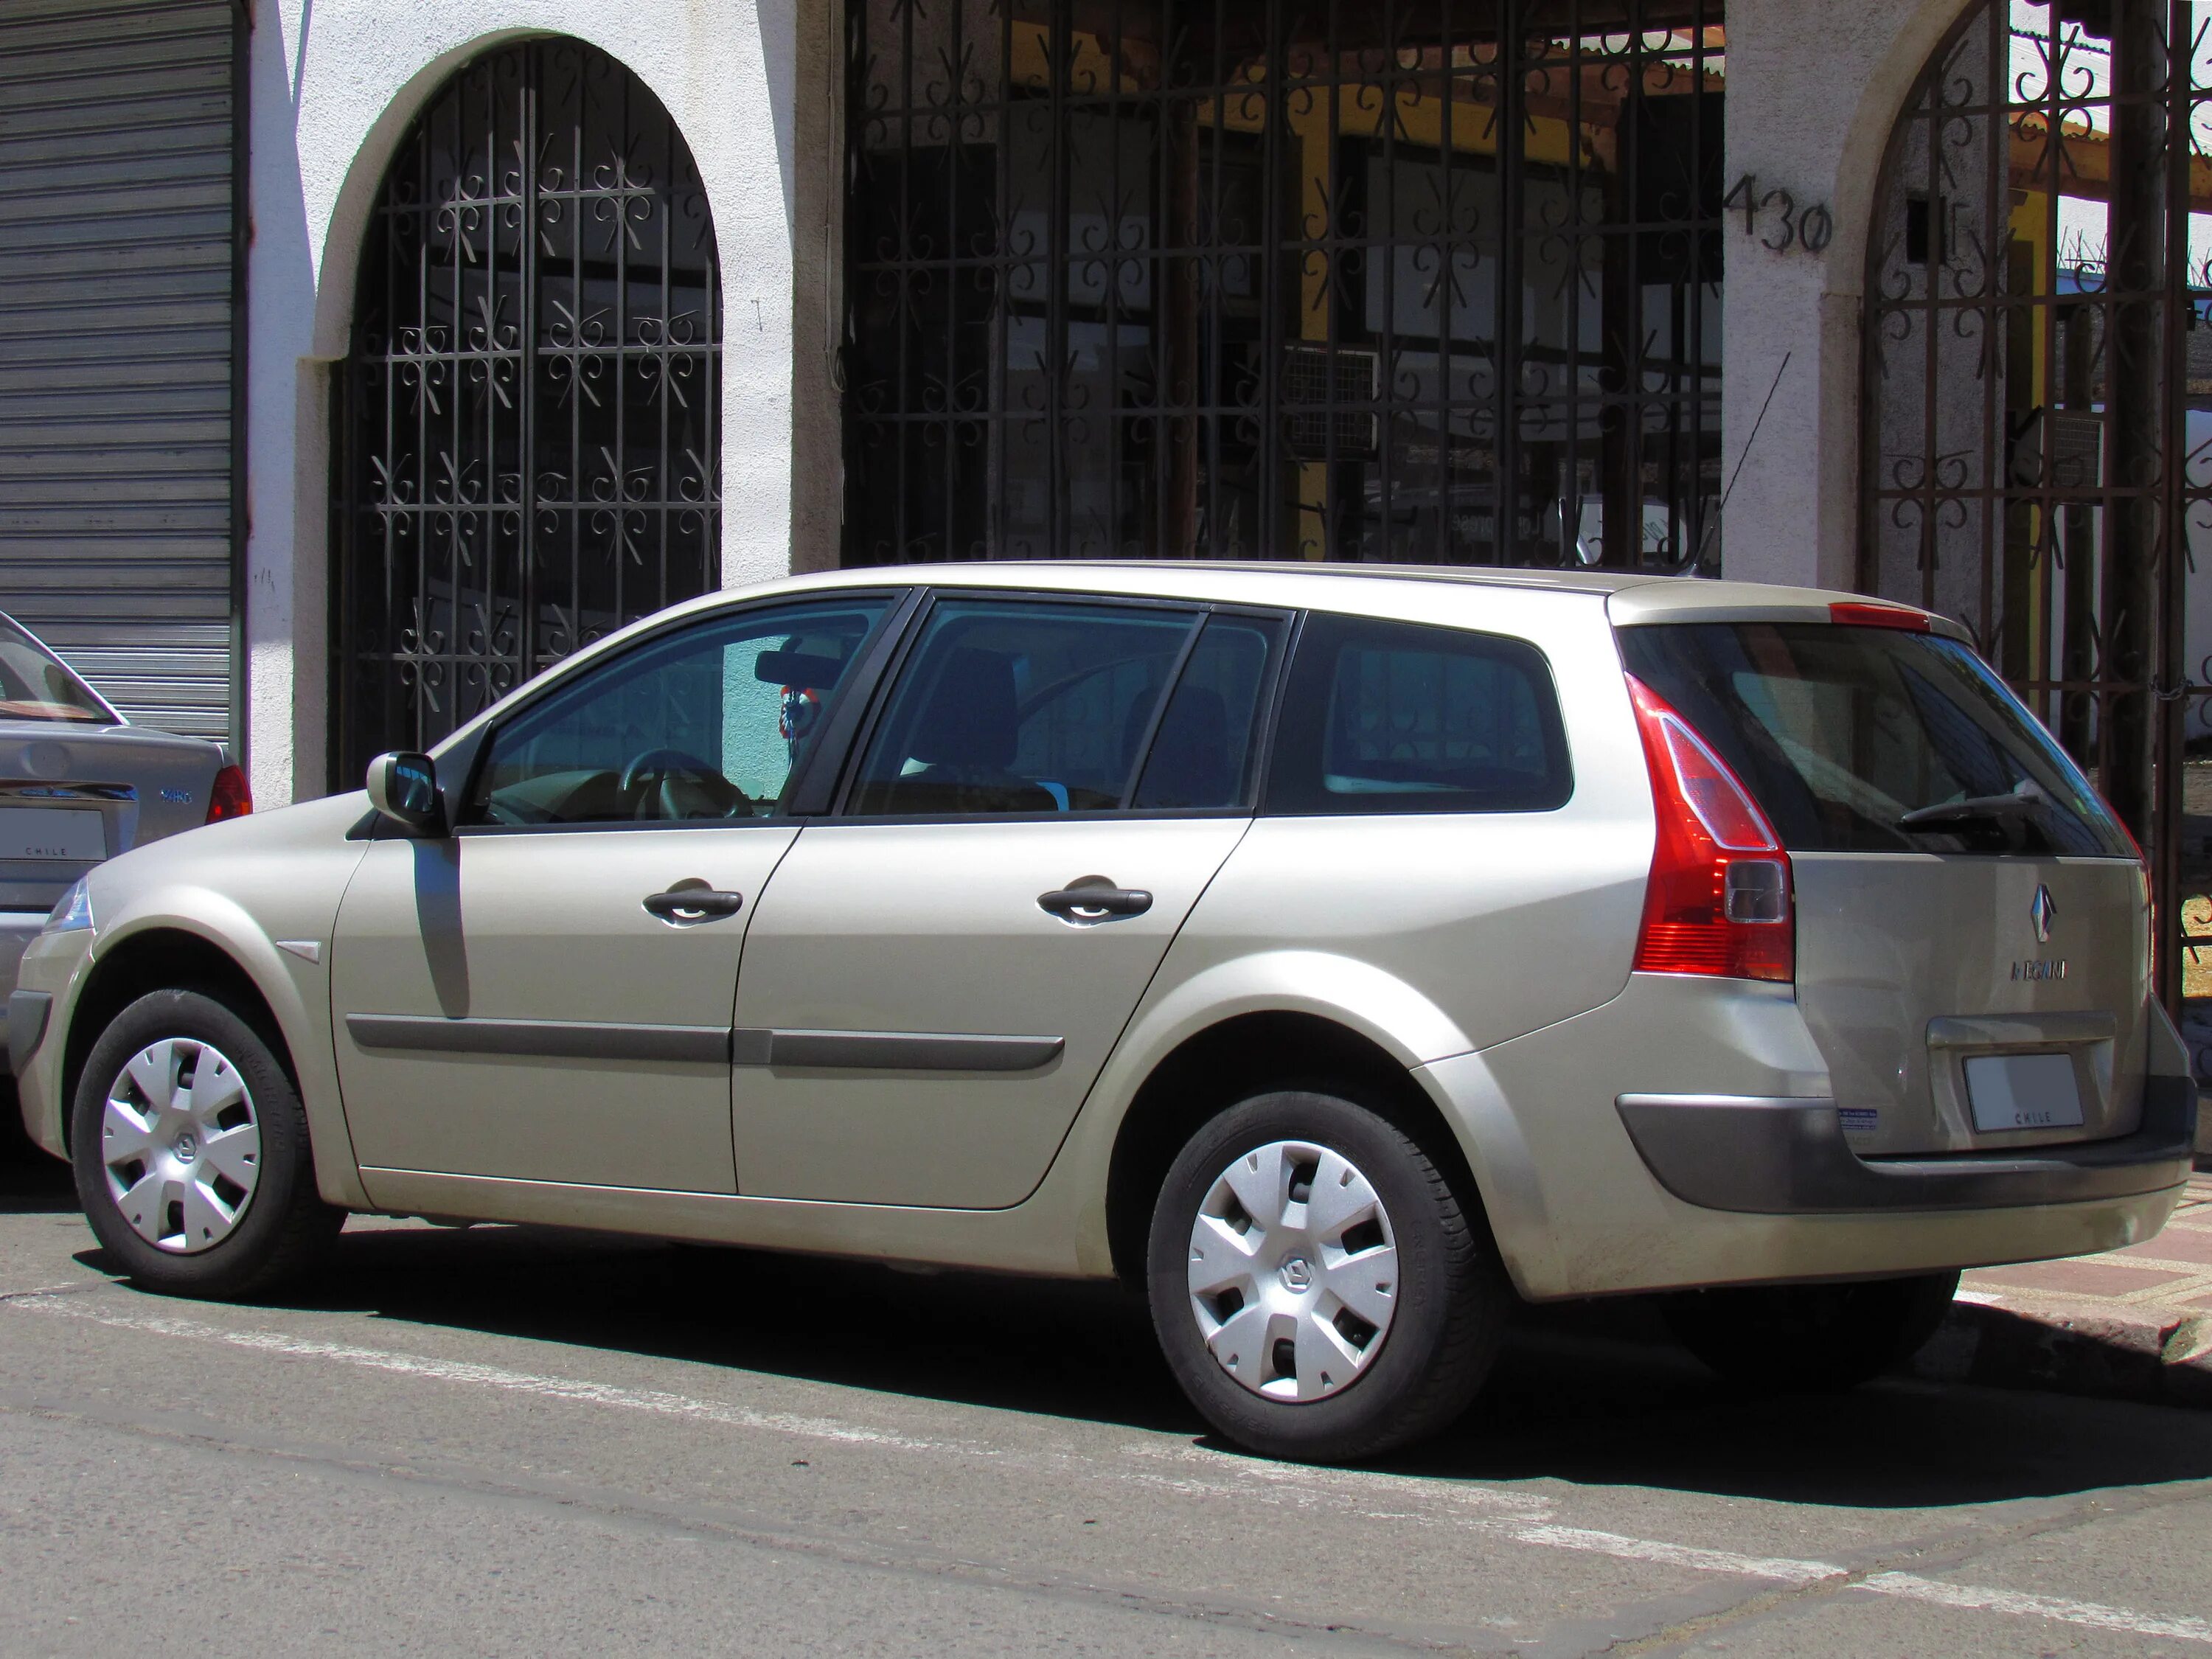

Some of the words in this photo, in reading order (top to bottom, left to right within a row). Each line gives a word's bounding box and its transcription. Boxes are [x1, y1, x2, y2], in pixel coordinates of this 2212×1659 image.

[1722, 173, 1832, 255] 430
[25, 847, 67, 856] CHILE
[2014, 1111, 2051, 1124] CHILE
